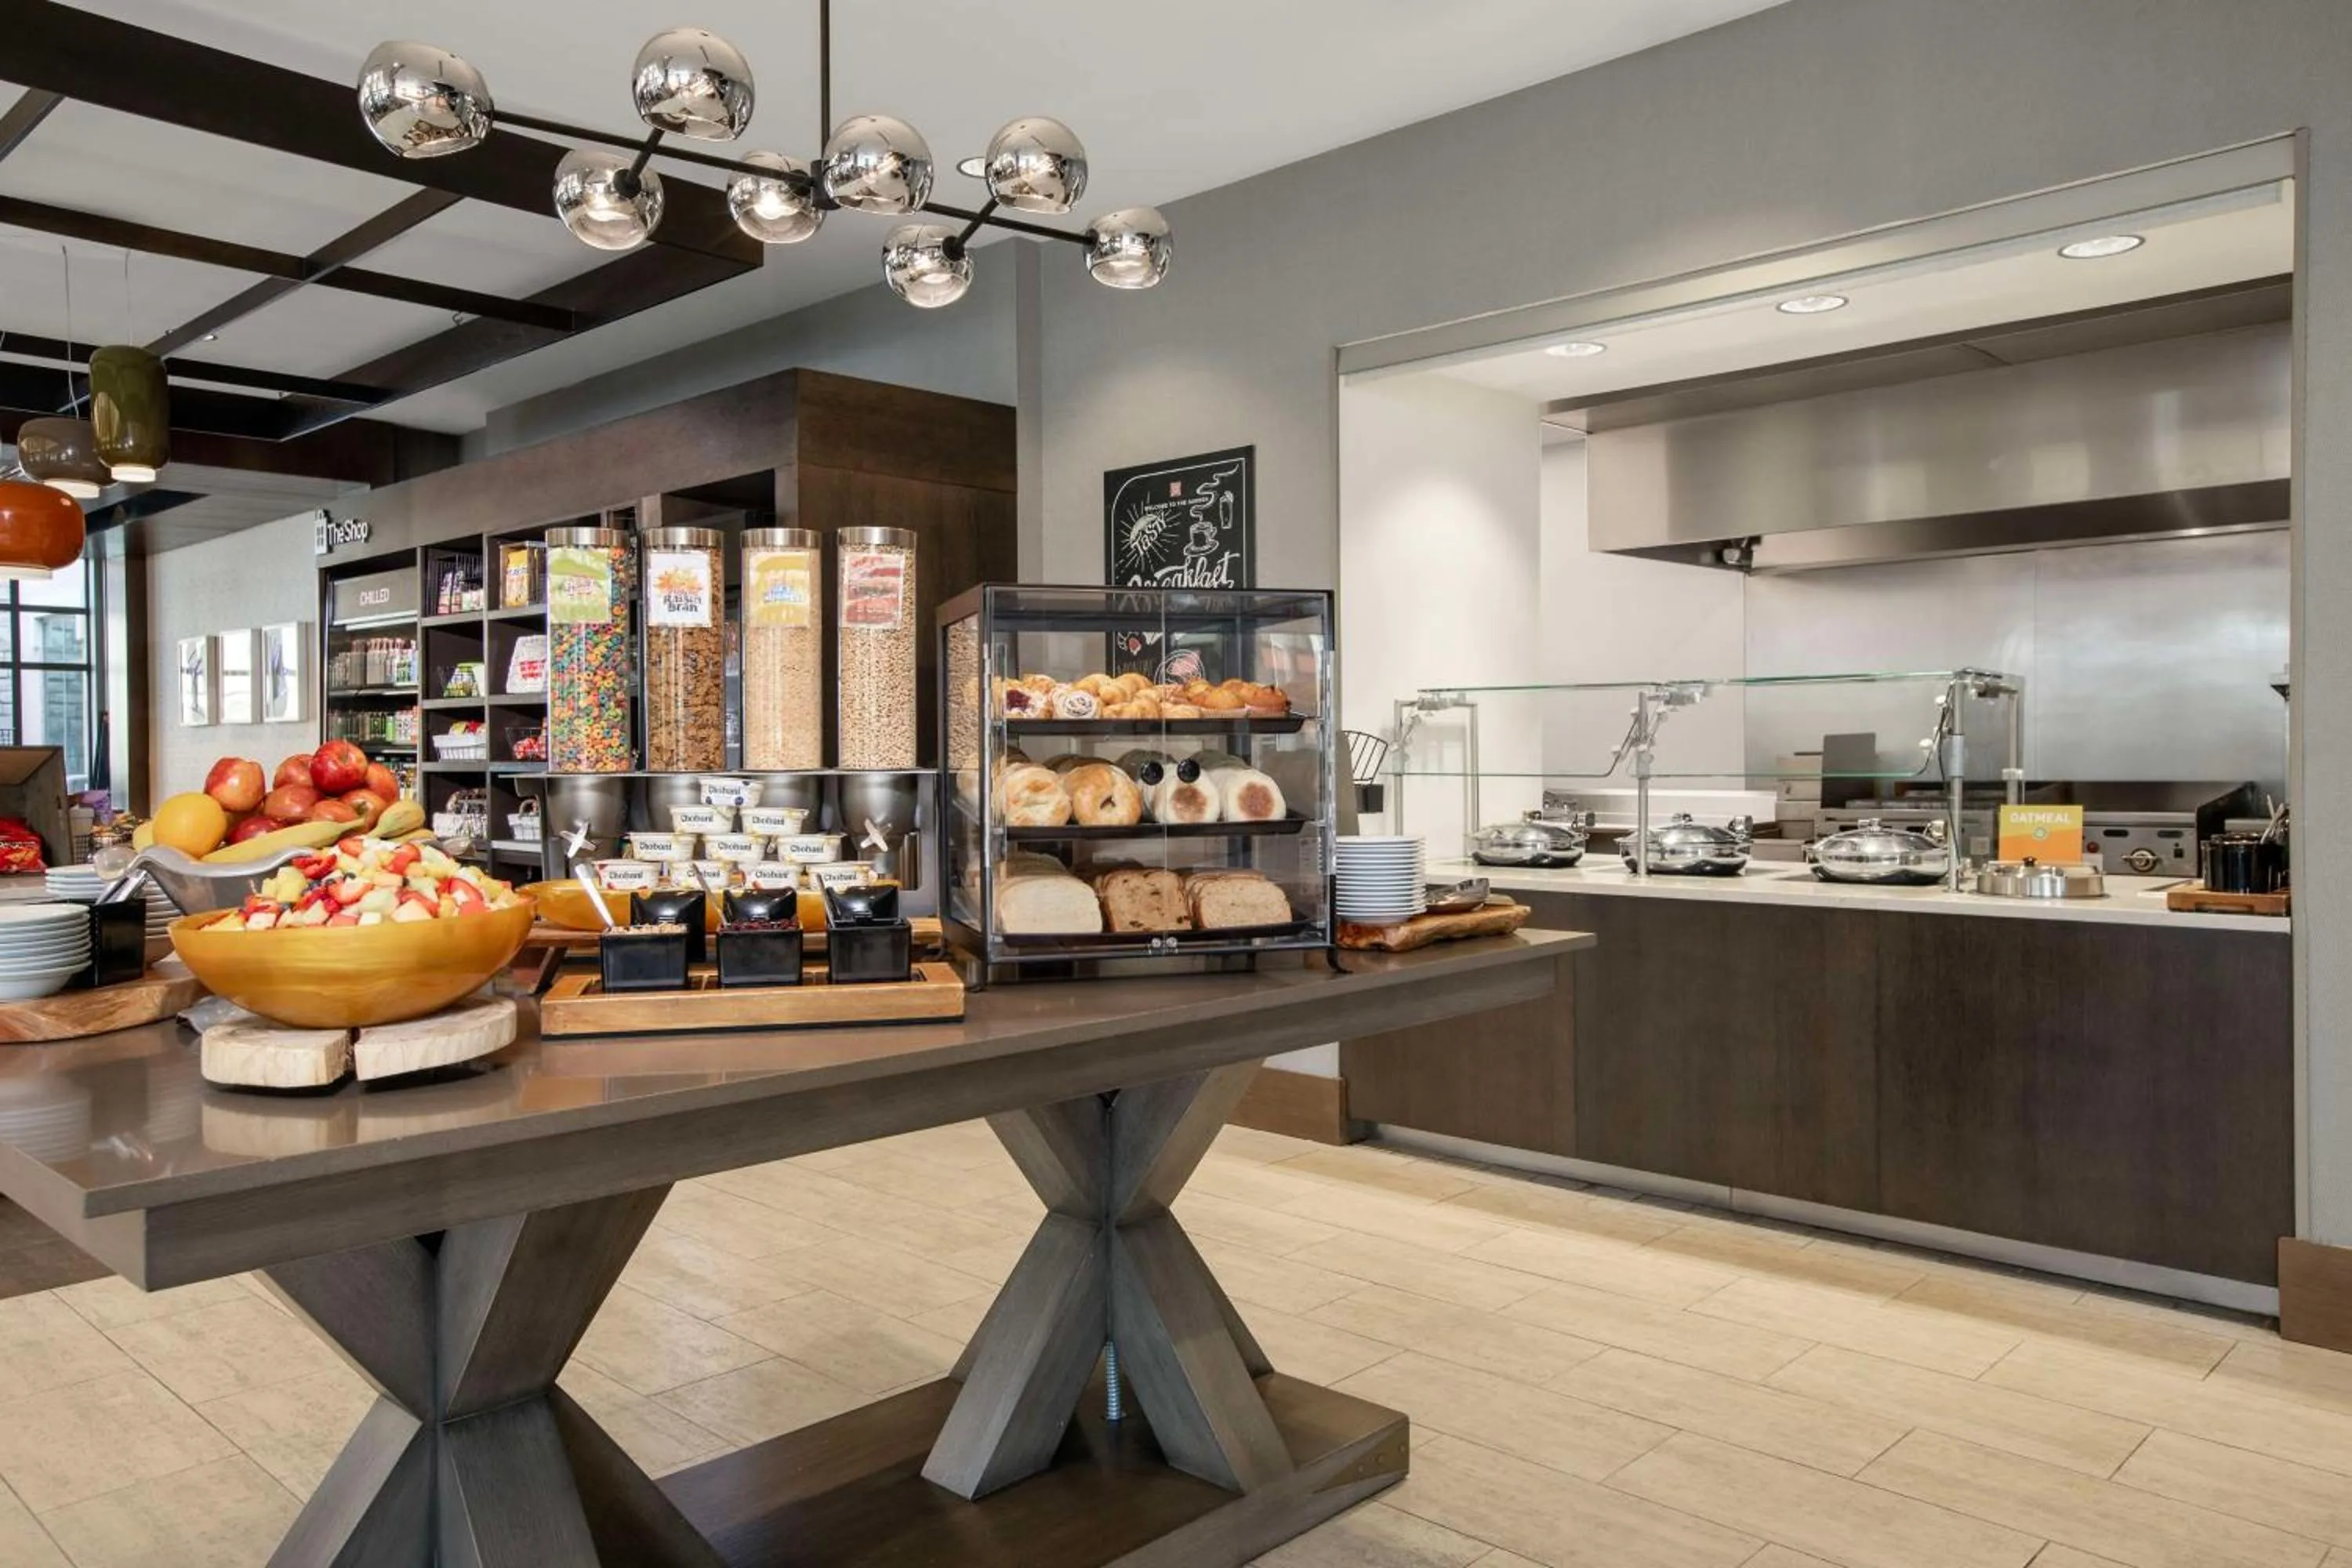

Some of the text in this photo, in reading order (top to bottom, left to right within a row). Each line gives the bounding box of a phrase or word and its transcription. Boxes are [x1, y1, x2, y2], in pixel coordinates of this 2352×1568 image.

[360, 588, 390, 607] CHILLED
[708, 785, 742, 795] Chobani
[681, 814, 714, 823] Chobani
[752, 815, 785, 826] Chobani
[2009, 811, 2071, 824] OATMEAL
[639, 841, 673, 851] Chobani
[717, 840, 753, 851] Chobani
[789, 844, 825, 854] Chobani
[608, 870, 644, 880] Chobani
[686, 869, 720, 879] Cbani
[755, 870, 789, 880] Chobani
